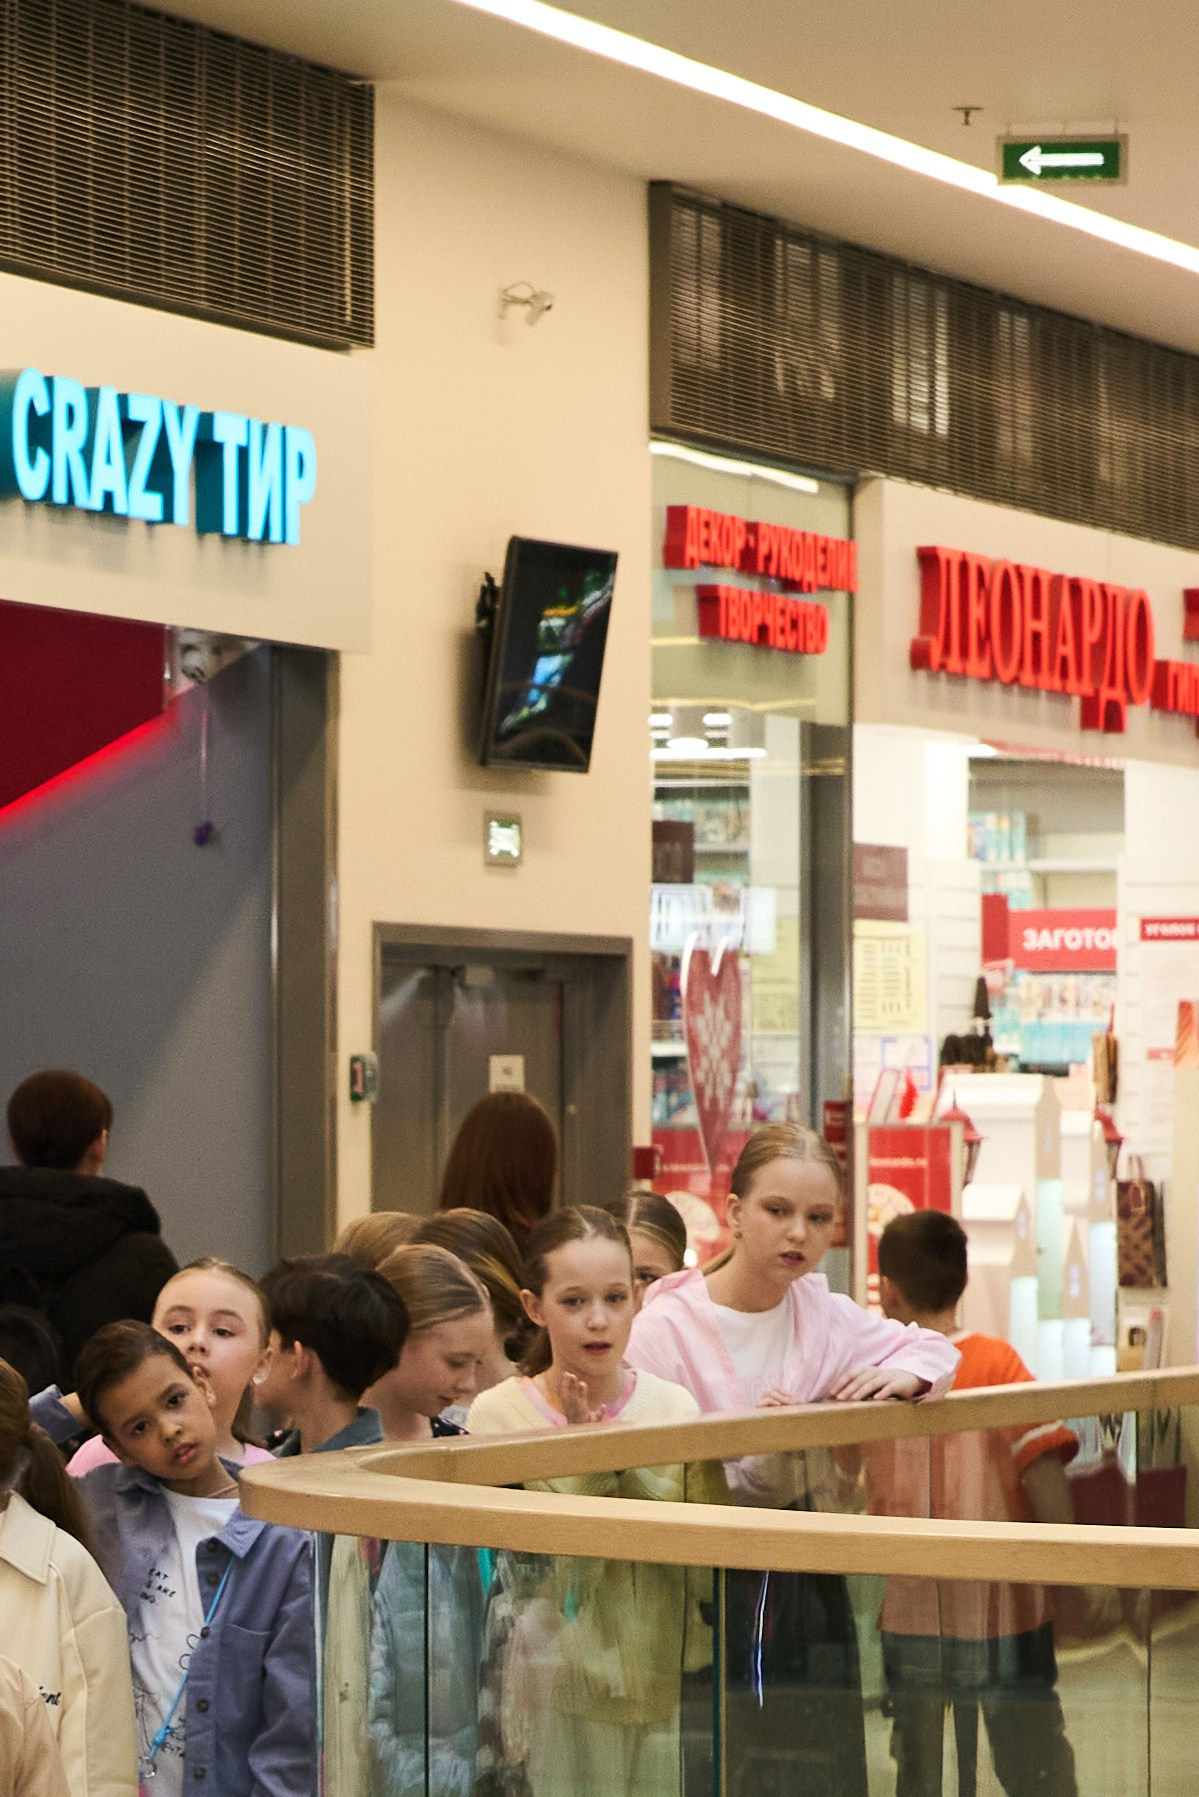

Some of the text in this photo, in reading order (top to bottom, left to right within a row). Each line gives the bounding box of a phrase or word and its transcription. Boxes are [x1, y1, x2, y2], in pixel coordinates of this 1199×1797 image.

[11, 366, 201, 527] CRAZY
[212, 411, 317, 546] ТИР
[718, 584, 830, 656] ТВОРЧЕСТВО
[929, 545, 1156, 734] ЛЕОНАРДО
[1022, 927, 1117, 951] ЗАГОТО
